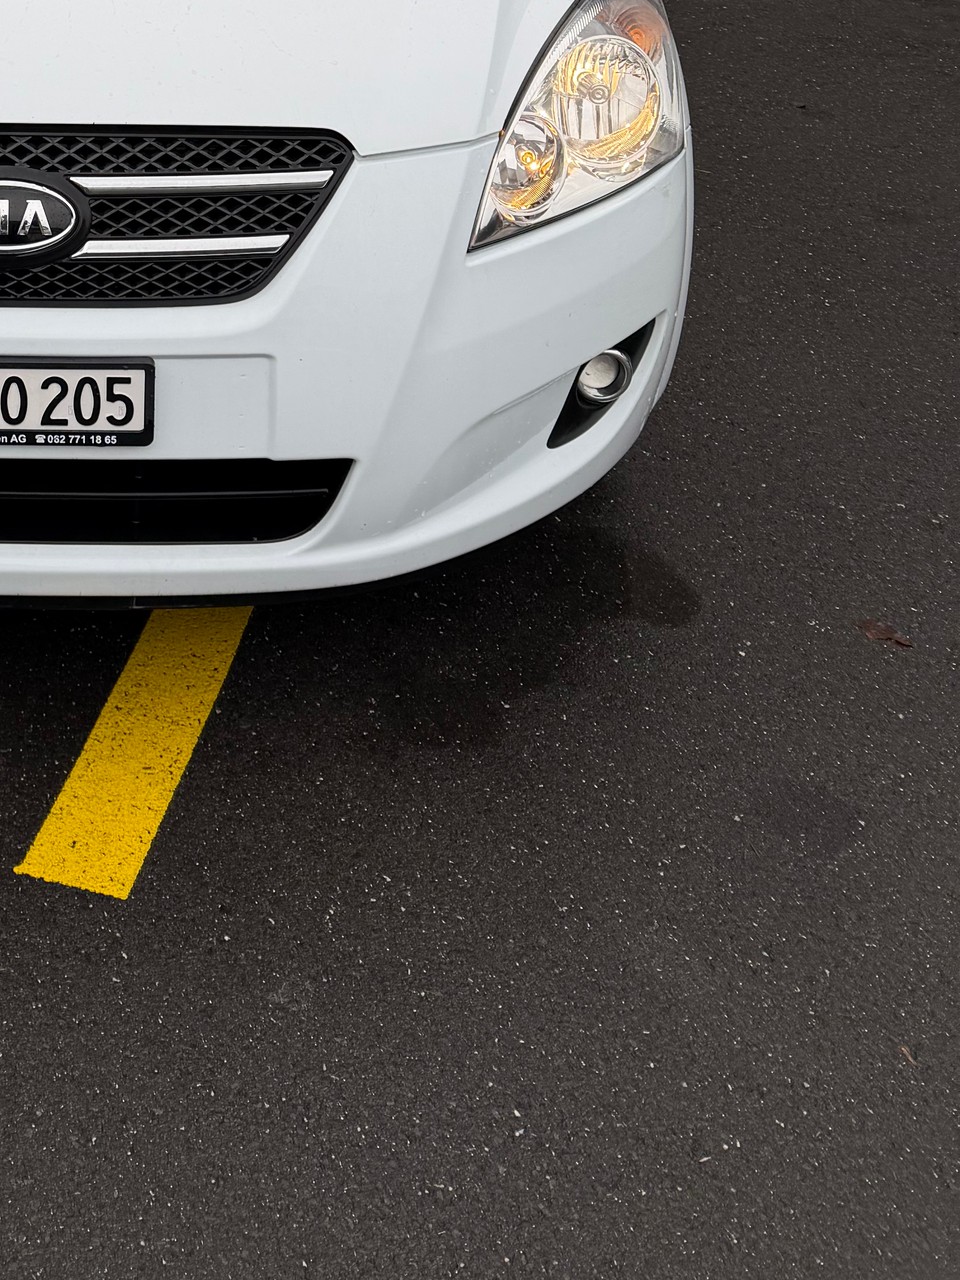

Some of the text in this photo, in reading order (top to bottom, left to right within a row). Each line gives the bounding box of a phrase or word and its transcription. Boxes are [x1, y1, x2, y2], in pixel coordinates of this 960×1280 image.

[40, 376, 135, 426] 205
[10, 434, 27, 443] AG
[68, 435, 86, 444] 771
[90, 435, 102, 444] 18
[104, 435, 117, 445] 65
